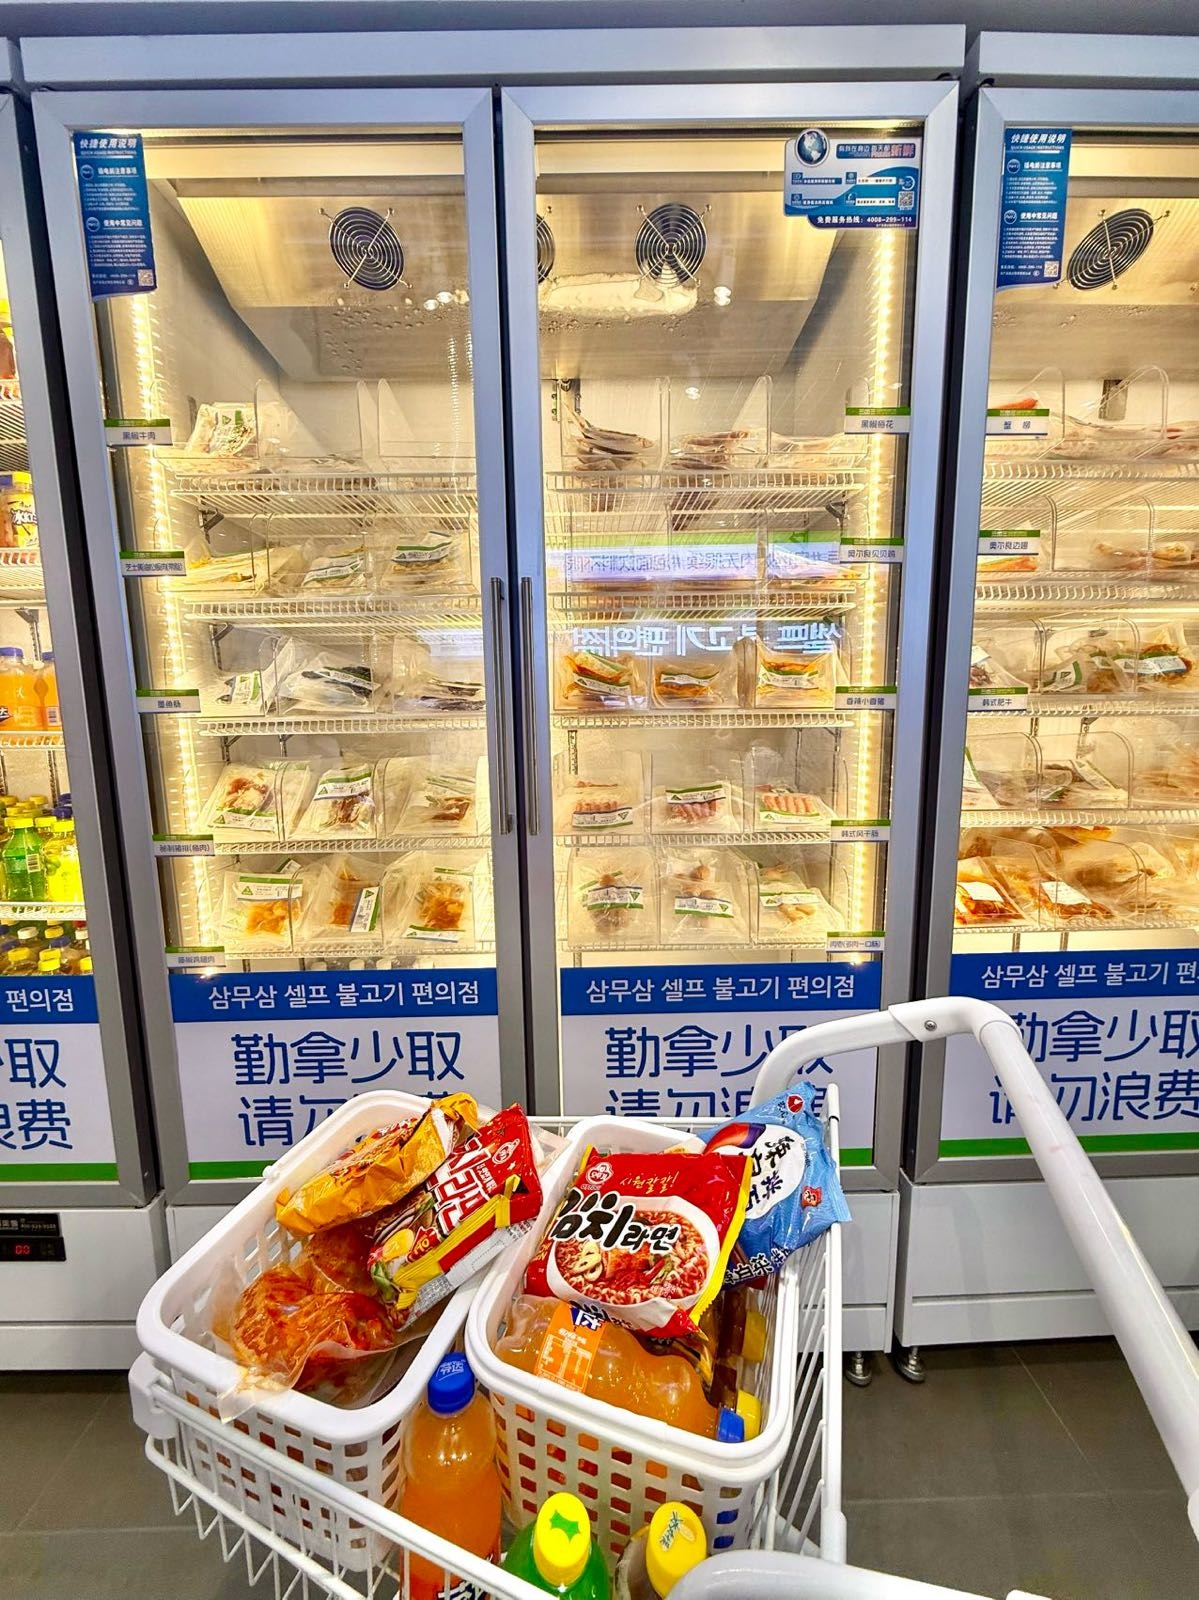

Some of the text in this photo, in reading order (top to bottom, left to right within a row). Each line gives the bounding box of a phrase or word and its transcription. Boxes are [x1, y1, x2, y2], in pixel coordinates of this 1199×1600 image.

[80, 138, 137, 149] 快捷使用说明
[1010, 133, 1067, 144] 快捷使用说明
[585, 974, 856, 1004] 삼무삼 셀프 불고기 편의점
[981, 965, 1049, 990] 삼무삼
[1054, 963, 1099, 986] 셀프
[1104, 961, 1170, 986] 불고기
[5, 988, 75, 1013] 편의점
[208, 980, 480, 1011] 삼무삼 셀프 불고기 편의점
[0, 1038, 67, 1089] 取
[230, 1029, 466, 1087] 勤拿少取
